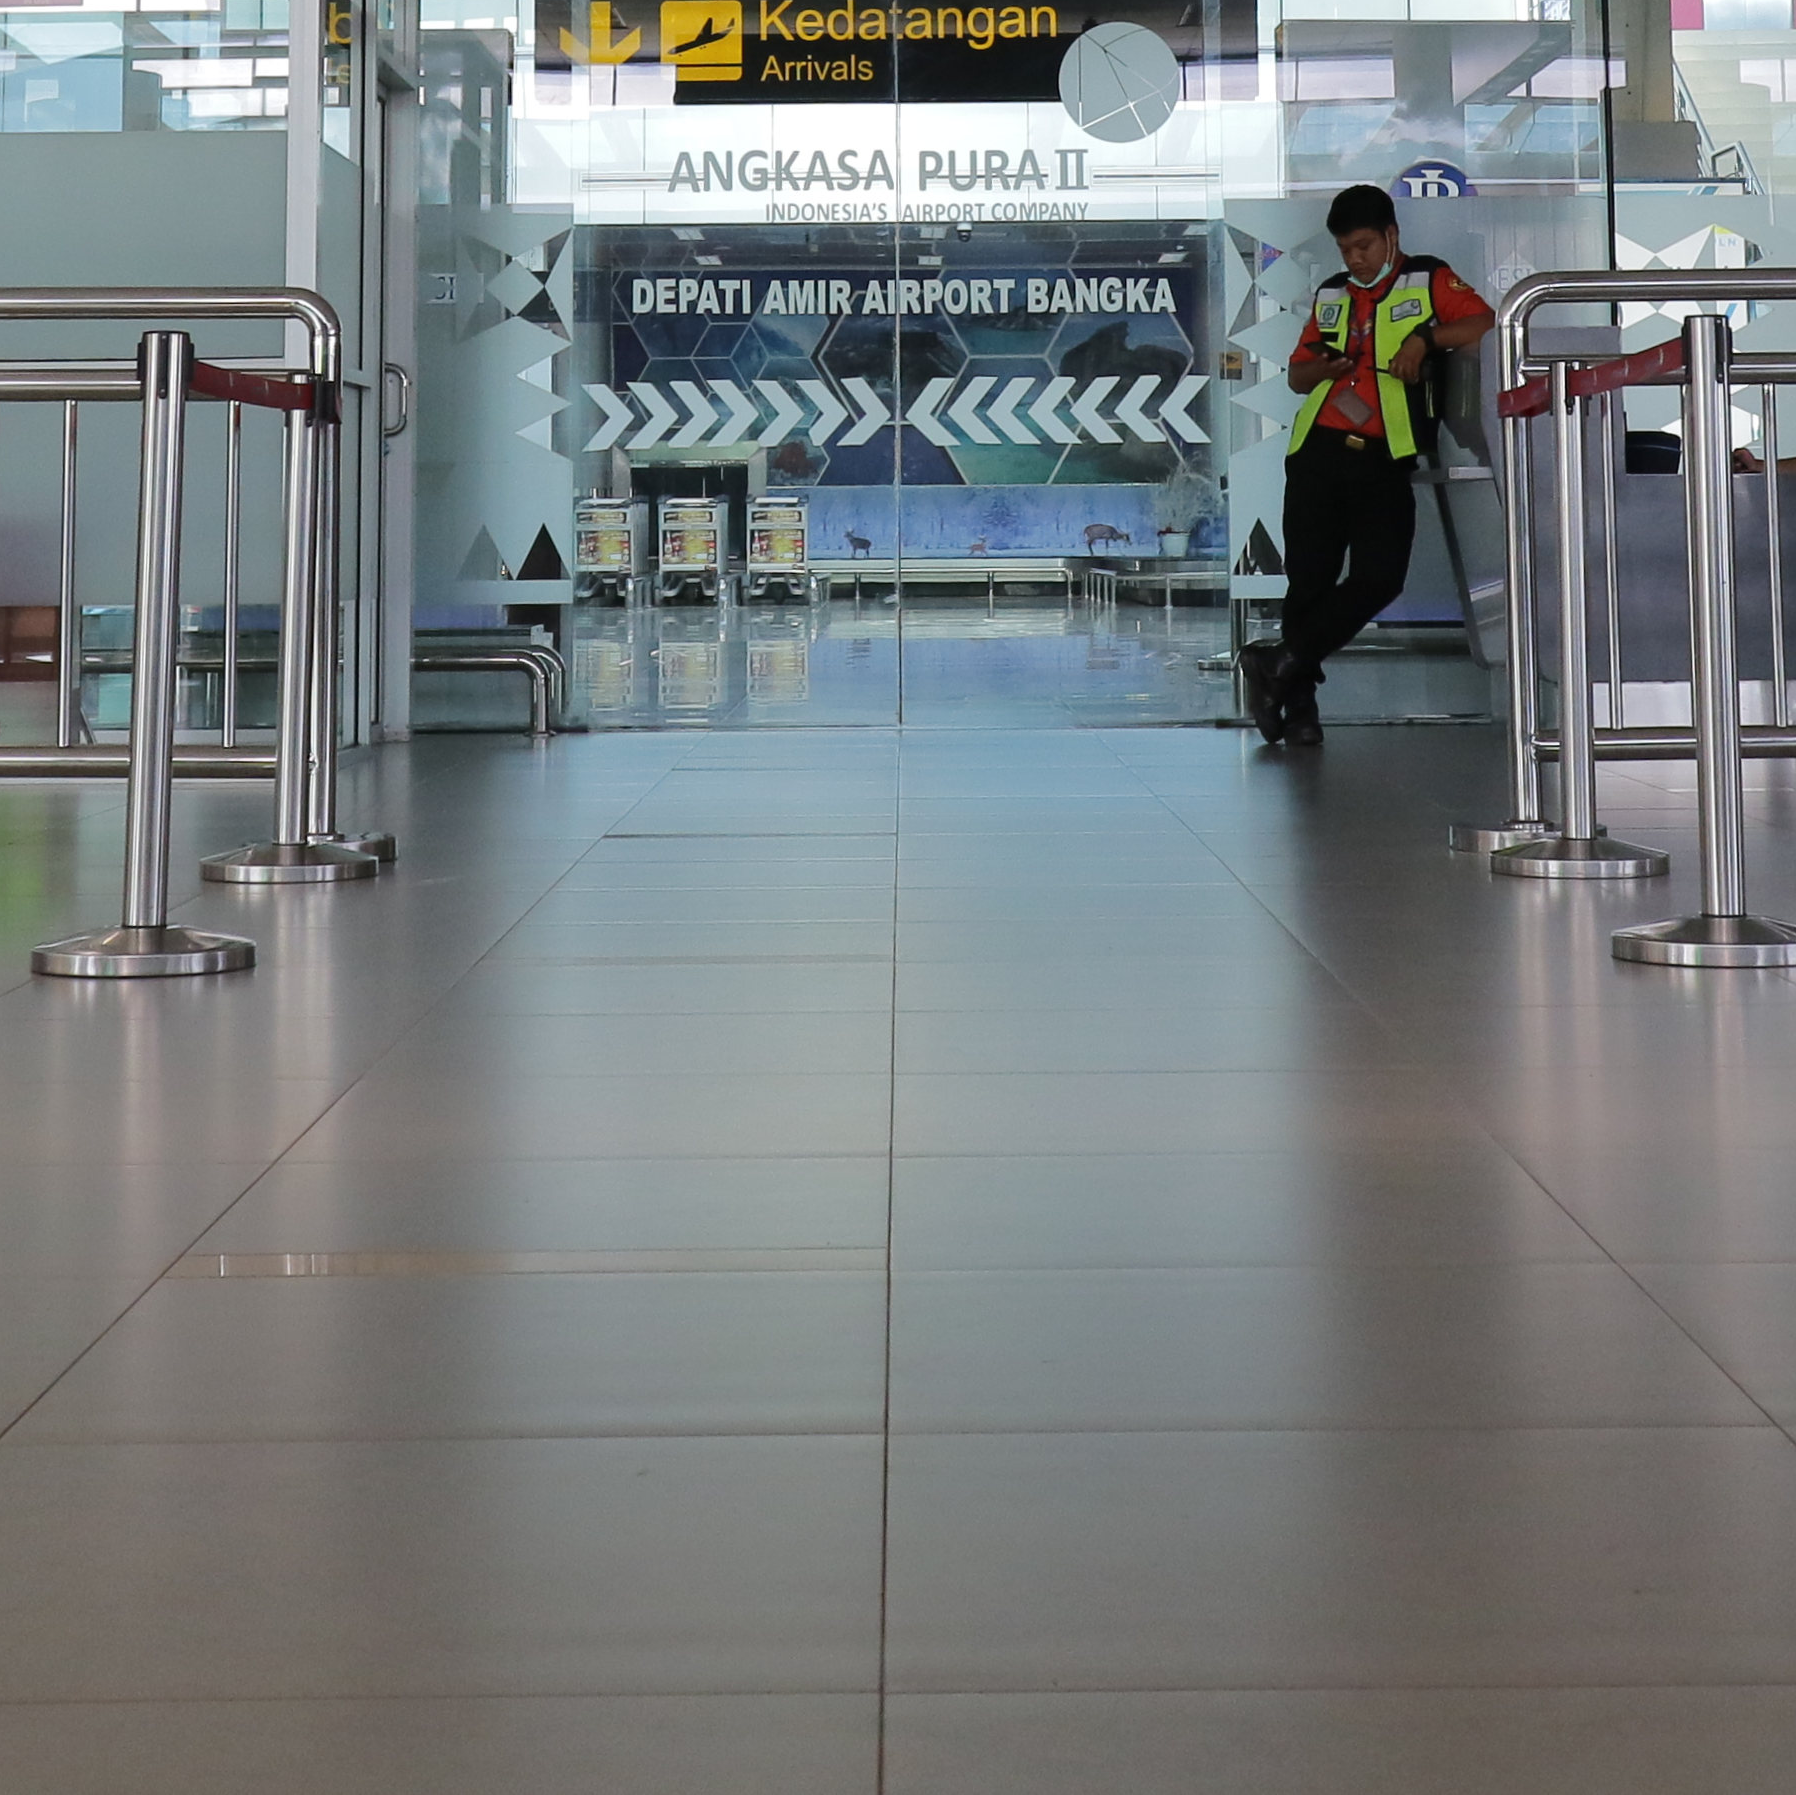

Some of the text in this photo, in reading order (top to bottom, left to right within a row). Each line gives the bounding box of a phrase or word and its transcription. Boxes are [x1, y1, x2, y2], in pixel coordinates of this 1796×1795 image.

[760, 54, 874, 82] Arrivals
[668, 149, 895, 193] ANGKASA
[918, 148, 1046, 192] PURA
[903, 202, 983, 222] AIRPORT
[991, 202, 1089, 222] COMPANY
[632, 277, 1177, 315] DEPATI AMIR AIRPORT BANGKA
